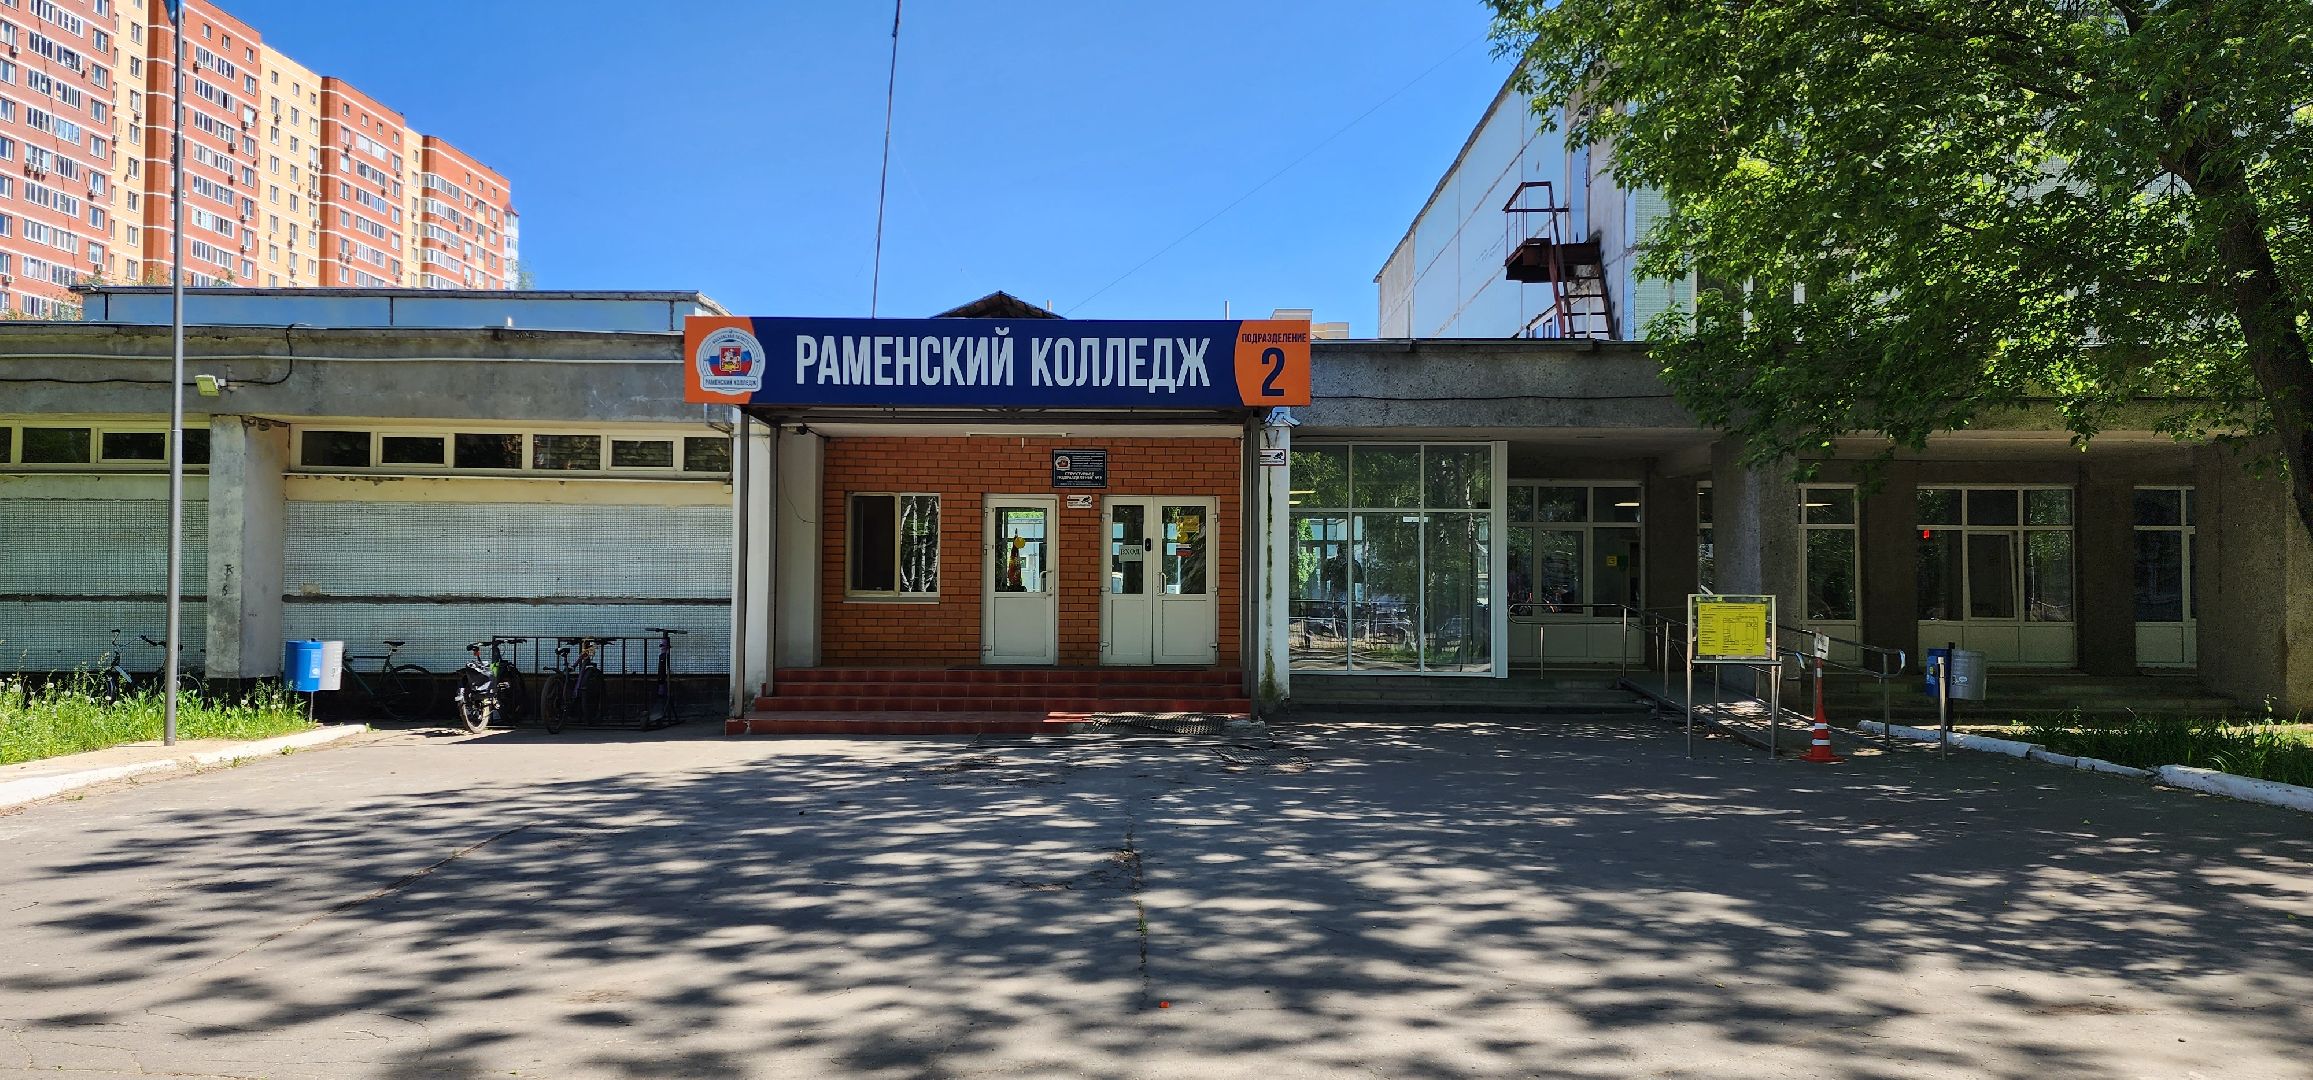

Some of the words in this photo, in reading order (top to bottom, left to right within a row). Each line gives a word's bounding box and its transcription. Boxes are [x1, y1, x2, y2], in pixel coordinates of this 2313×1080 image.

[1241, 333, 1307, 344] ПОДРАЗДЕЛЕНИЕ
[796, 326, 1014, 387] РАМЕНСКИЙ
[1031, 337, 1211, 394] КОЛЛЕДЖ
[1261, 347, 1285, 397] 2
[705, 378, 732, 386] РАМЕНСКИЙ
[733, 379, 757, 387] КОЛЛЕДЖ
[1120, 548, 1141, 556] ВХОД
